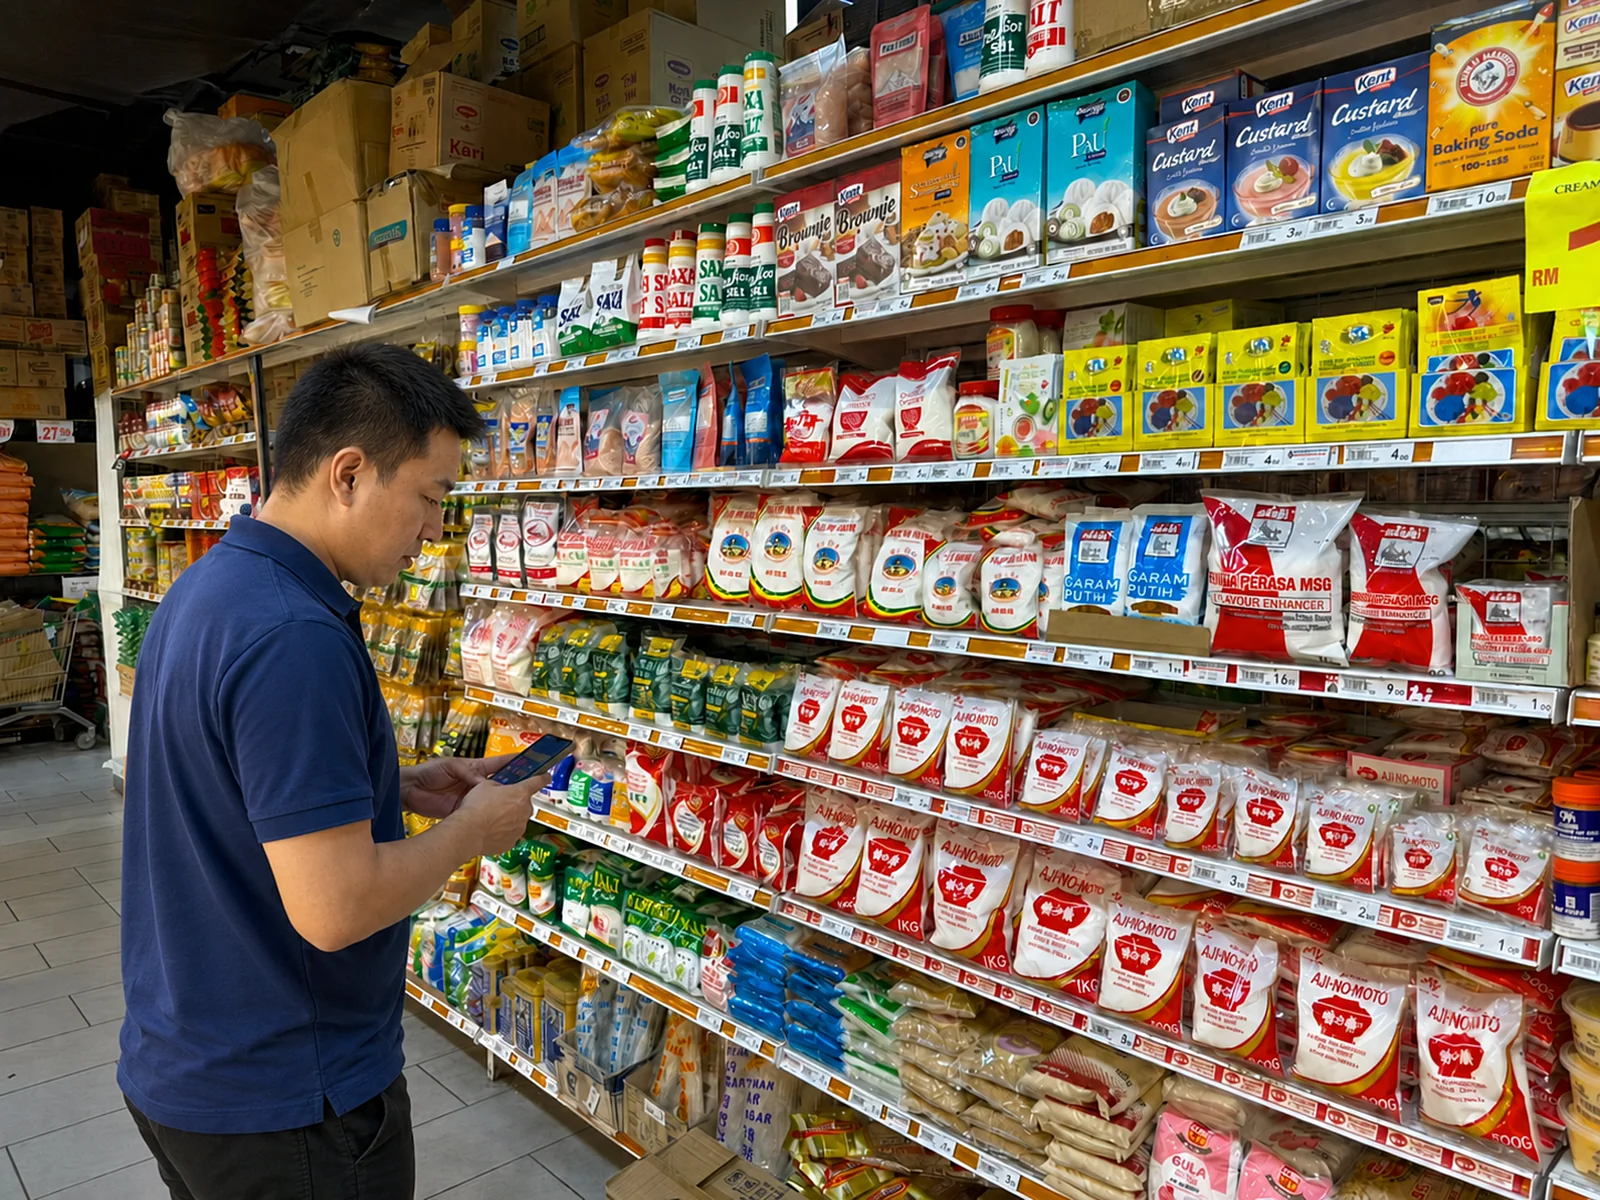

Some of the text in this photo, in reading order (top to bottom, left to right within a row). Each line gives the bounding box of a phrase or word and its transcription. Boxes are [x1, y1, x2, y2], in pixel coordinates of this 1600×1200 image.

[1358, 71, 1392, 92] Kent
[1185, 93, 1212, 110] Kent
[1258, 95, 1291, 114] Kent
[1332, 90, 1414, 127] Custard
[1169, 121, 1196, 138] Kent
[1236, 114, 1312, 148] Custard
[1470, 121, 1499, 138] pure
[1433, 125, 1539, 157] Baking Soda
[1153, 141, 1214, 171] Custard
[836, 196, 896, 234] Brownie
[777, 214, 831, 249] Brownie
[1532, 267, 1559, 287] RM
[1065, 576, 1119, 590] GARAM
[1128, 570, 1187, 586] GARAM
[1240, 576, 1297, 591] PERASA
[1300, 577, 1332, 592] MSG
[1128, 584, 1173, 598] PUTIH
[1415, 595, 1439, 606] MSG
[1263, 598, 1325, 610] ENHANCER
[1172, 1155, 1206, 1178] GULA
